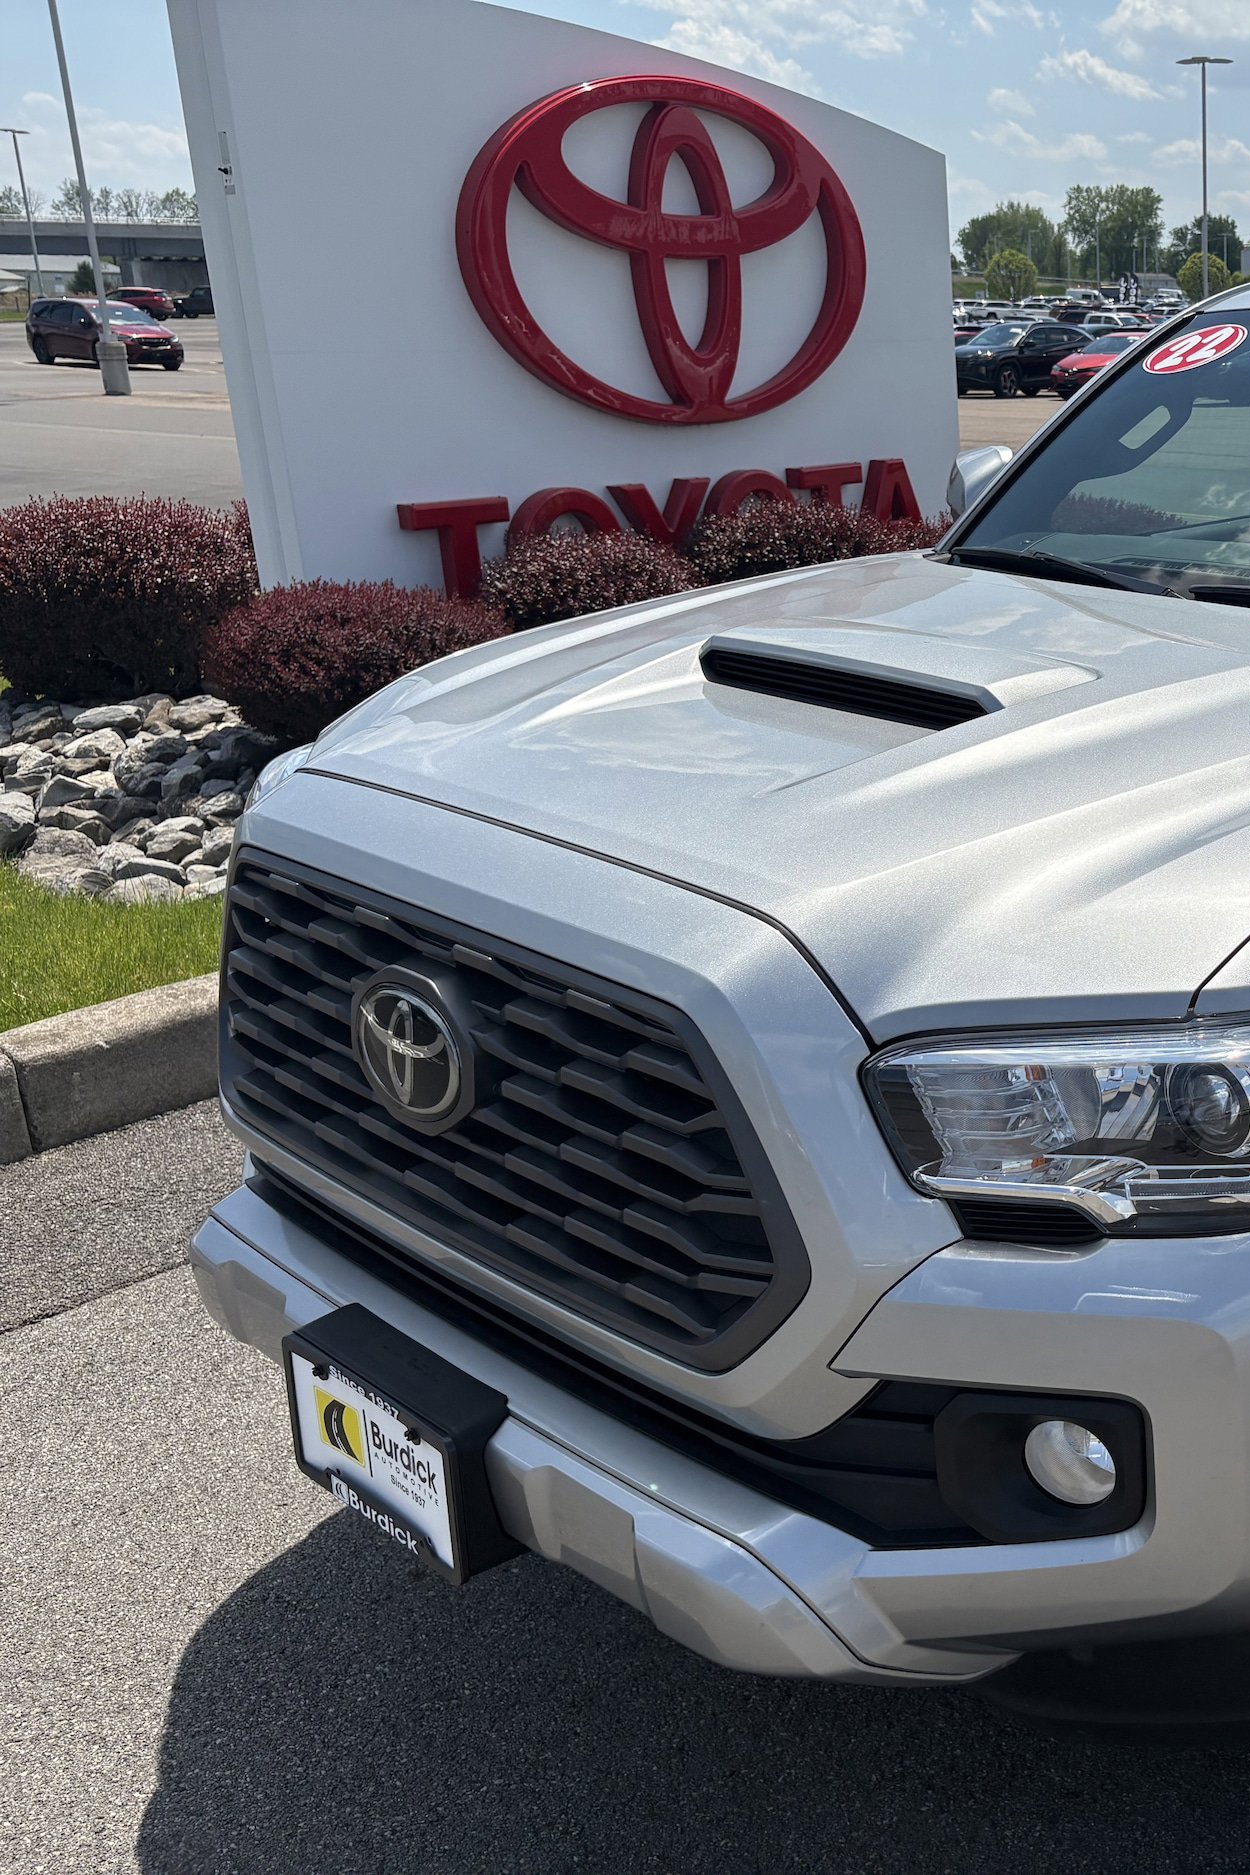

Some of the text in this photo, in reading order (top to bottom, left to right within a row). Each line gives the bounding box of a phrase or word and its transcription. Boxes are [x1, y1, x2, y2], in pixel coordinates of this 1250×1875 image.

[1153, 326, 1235, 370] 22
[329, 1365, 399, 1420] Since 1937
[371, 1420, 438, 1495] Burdick
[374, 1452, 439, 1507] AUTOMOTIVE
[390, 1474, 426, 1509] Since 1937
[348, 1488, 419, 1555] Burdick
